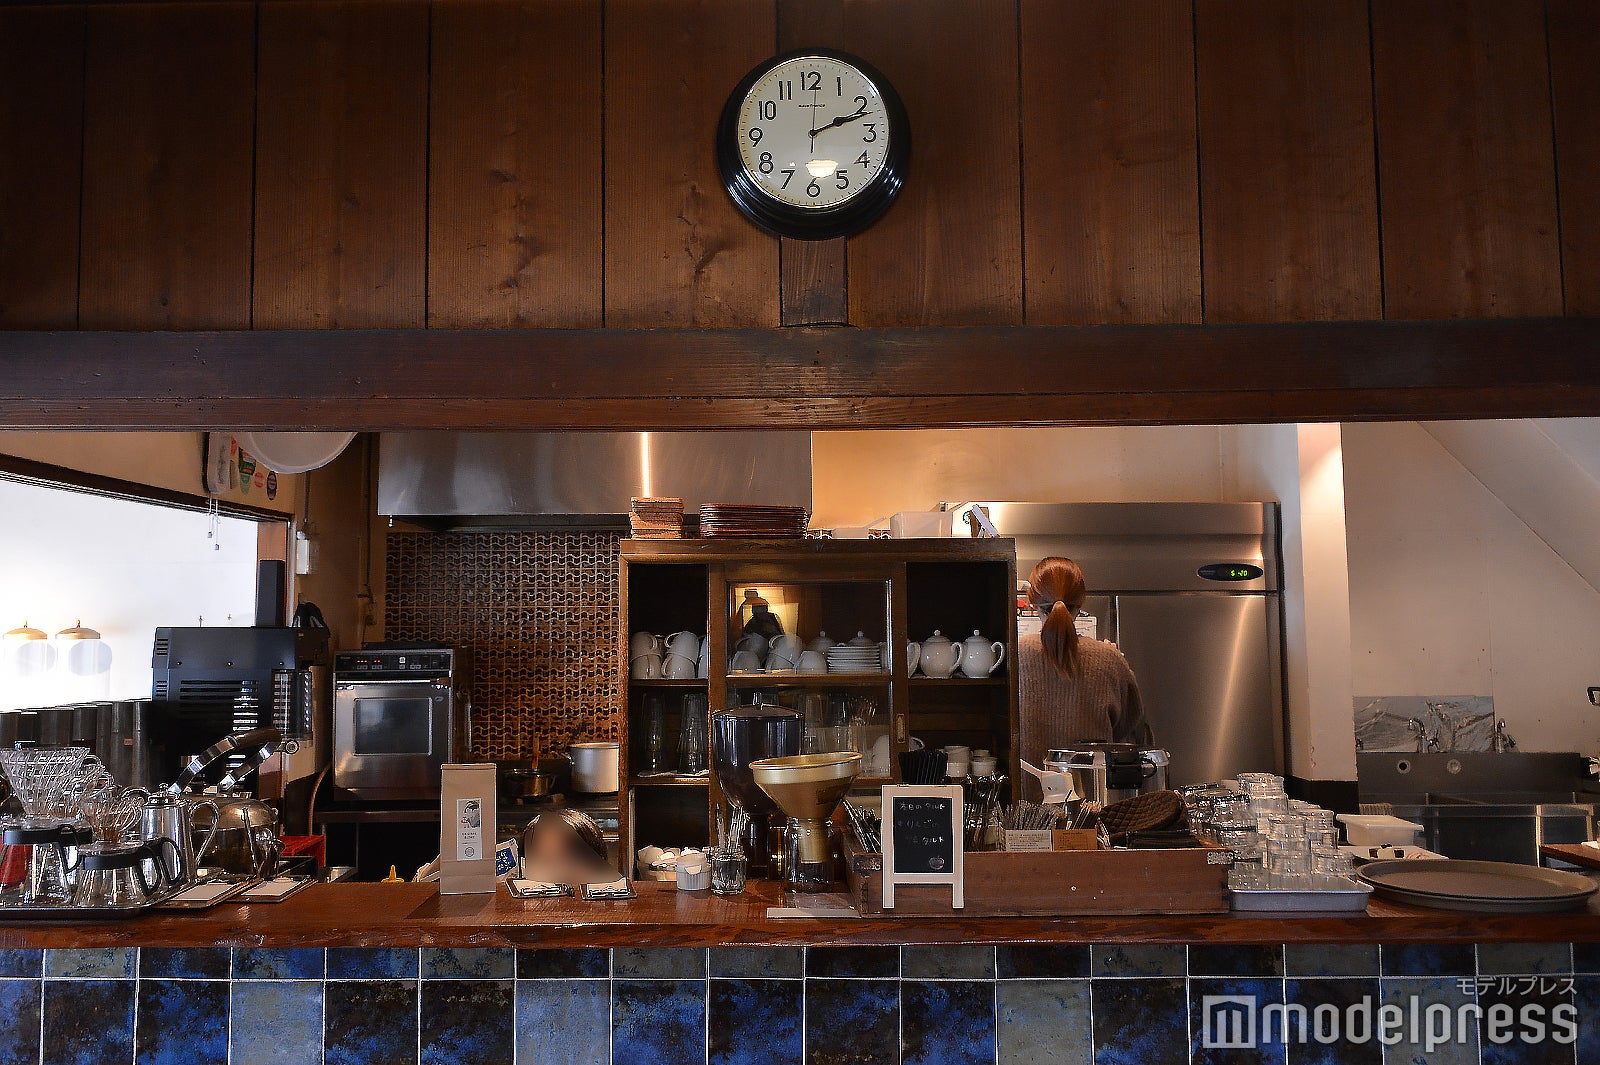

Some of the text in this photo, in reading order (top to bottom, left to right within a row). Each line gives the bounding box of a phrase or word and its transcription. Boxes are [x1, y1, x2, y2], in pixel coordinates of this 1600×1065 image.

[778, 80, 792, 100] 11
[800, 71, 822, 91] 12
[836, 77, 842, 96] 1
[758, 100, 777, 120] 10
[853, 95, 868, 114] 2
[748, 127, 763, 147] 9
[862, 123, 877, 142] 3
[758, 152, 774, 174] 8
[853, 150, 870, 168] 4
[780, 169, 795, 189] 7
[806, 177, 821, 197] 6
[835, 170, 849, 190] 5
